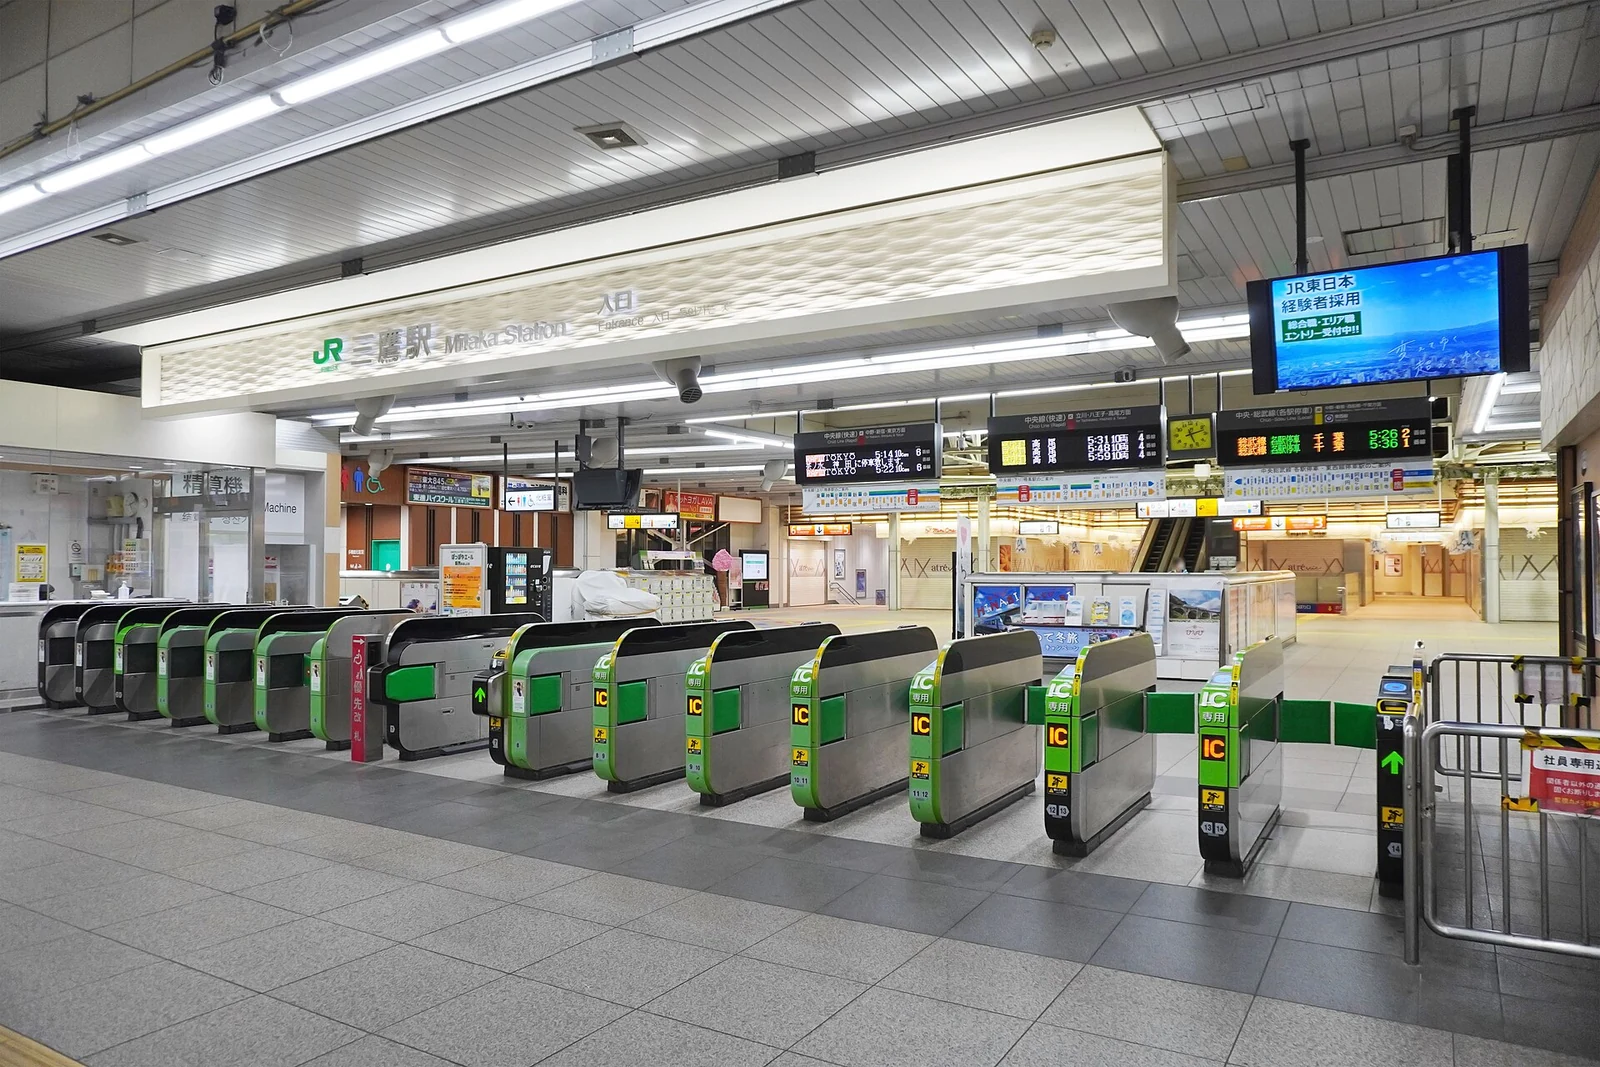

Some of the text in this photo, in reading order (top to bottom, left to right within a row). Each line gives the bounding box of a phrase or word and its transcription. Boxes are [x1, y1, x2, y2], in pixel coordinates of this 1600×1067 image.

[1286, 275, 1354, 295] JR東日本
[1281, 292, 1360, 314] 経験者採用
[1288, 314, 1355, 329] 総合職・エリア職
[445, 320, 567, 354] Mitaka Station
[1284, 326, 1359, 341] エントリー受付中!!
[351, 322, 432, 364] 三鷹駅
[313, 338, 343, 365] JR
[1024, 413, 1066, 424] 中央線(快速)
[1087, 435, 1109, 445] 5:31
[1138, 433, 1144, 441] 4
[1369, 429, 1398, 439] 5:26
[1401, 428, 1410, 438] 2
[1088, 444, 1110, 453] 5:48
[1369, 438, 1399, 449] 5:36
[1403, 438, 1410, 447] 1
[825, 452, 856, 461] TOKYO
[875, 450, 894, 458] 5:14
[916, 448, 922, 456] 6
[1088, 452, 1110, 461] 5:59
[1139, 450, 1145, 458] 4
[825, 467, 857, 475] TOKYO
[875, 465, 895, 474] 5:22
[916, 463, 922, 471] 6
[183, 474, 243, 494] 精算機
[1235, 518, 1243, 529] 4
[1315, 518, 1323, 528] 3
[791, 526, 798, 535] 6
[843, 525, 849, 534] 5
[595, 655, 610, 668] IC
[689, 662, 705, 675] IC
[594, 672, 607, 680] 専用
[794, 669, 812, 682] IC
[688, 678, 701, 687] 専用
[913, 676, 934, 690] IC
[793, 686, 808, 694] 専用
[1048, 683, 1072, 698] IC
[596, 691, 608, 705] IC
[912, 694, 929, 703] 専用
[1201, 692, 1228, 708] IC
[689, 698, 702, 714] IC
[1048, 702, 1068, 712] 専用
[795, 707, 809, 723] IC
[1202, 712, 1225, 723] 専用
[914, 716, 930, 733] IC
[1050, 727, 1068, 746] IC
[1204, 739, 1225, 758] IC
[913, 790, 920, 798] 11
[1049, 806, 1067, 815] 12 13
[1204, 824, 1224, 833] 13 14
[1391, 845, 1399, 853] 14
